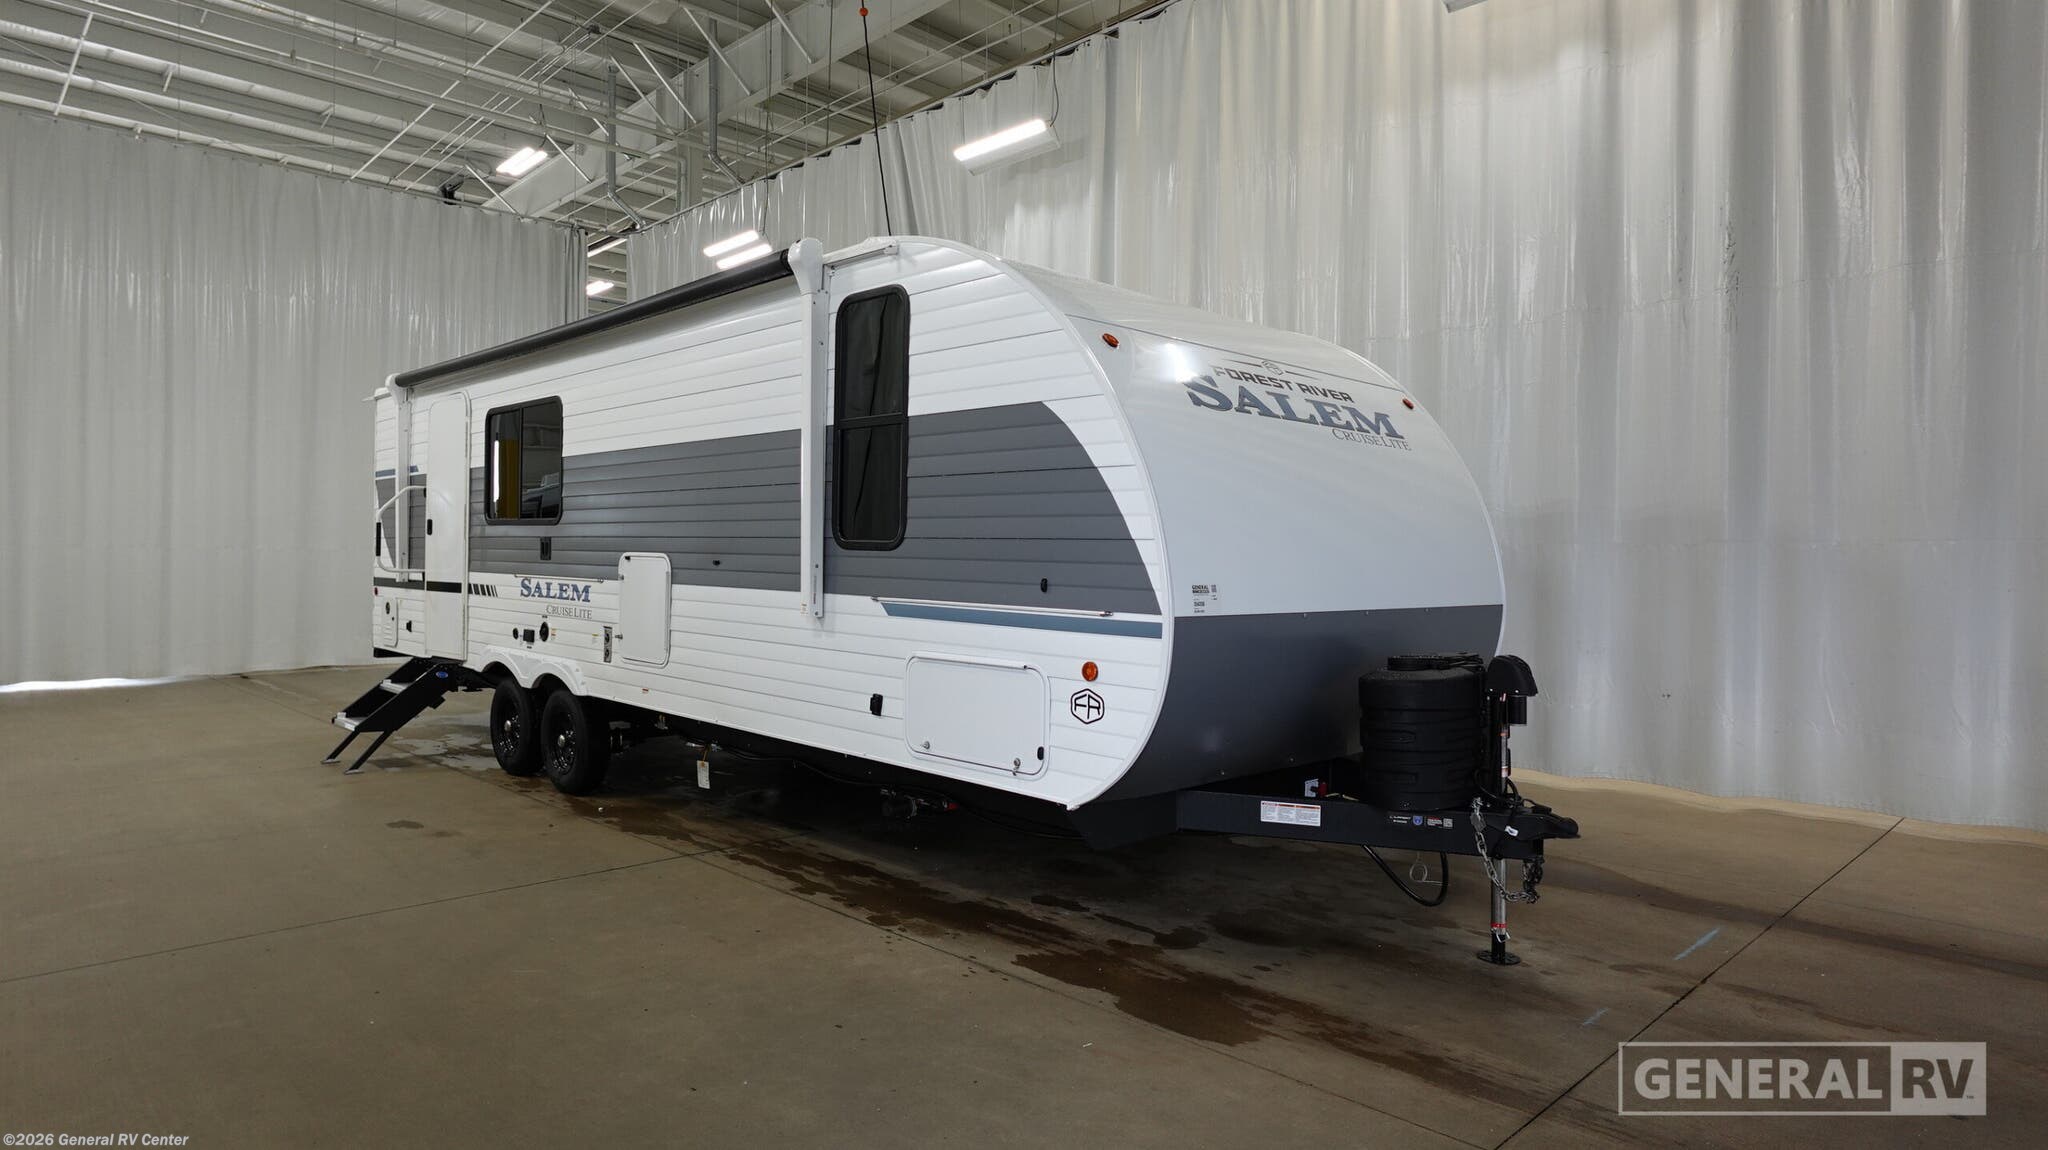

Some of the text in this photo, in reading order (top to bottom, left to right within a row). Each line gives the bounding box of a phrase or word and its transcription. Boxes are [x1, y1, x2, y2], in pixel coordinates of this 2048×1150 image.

[1210, 365, 1354, 403] FOREST RIVER
[1184, 375, 1405, 439] SALEM
[520, 577, 591, 603] SALEM
[1074, 693, 1101, 719] FR
